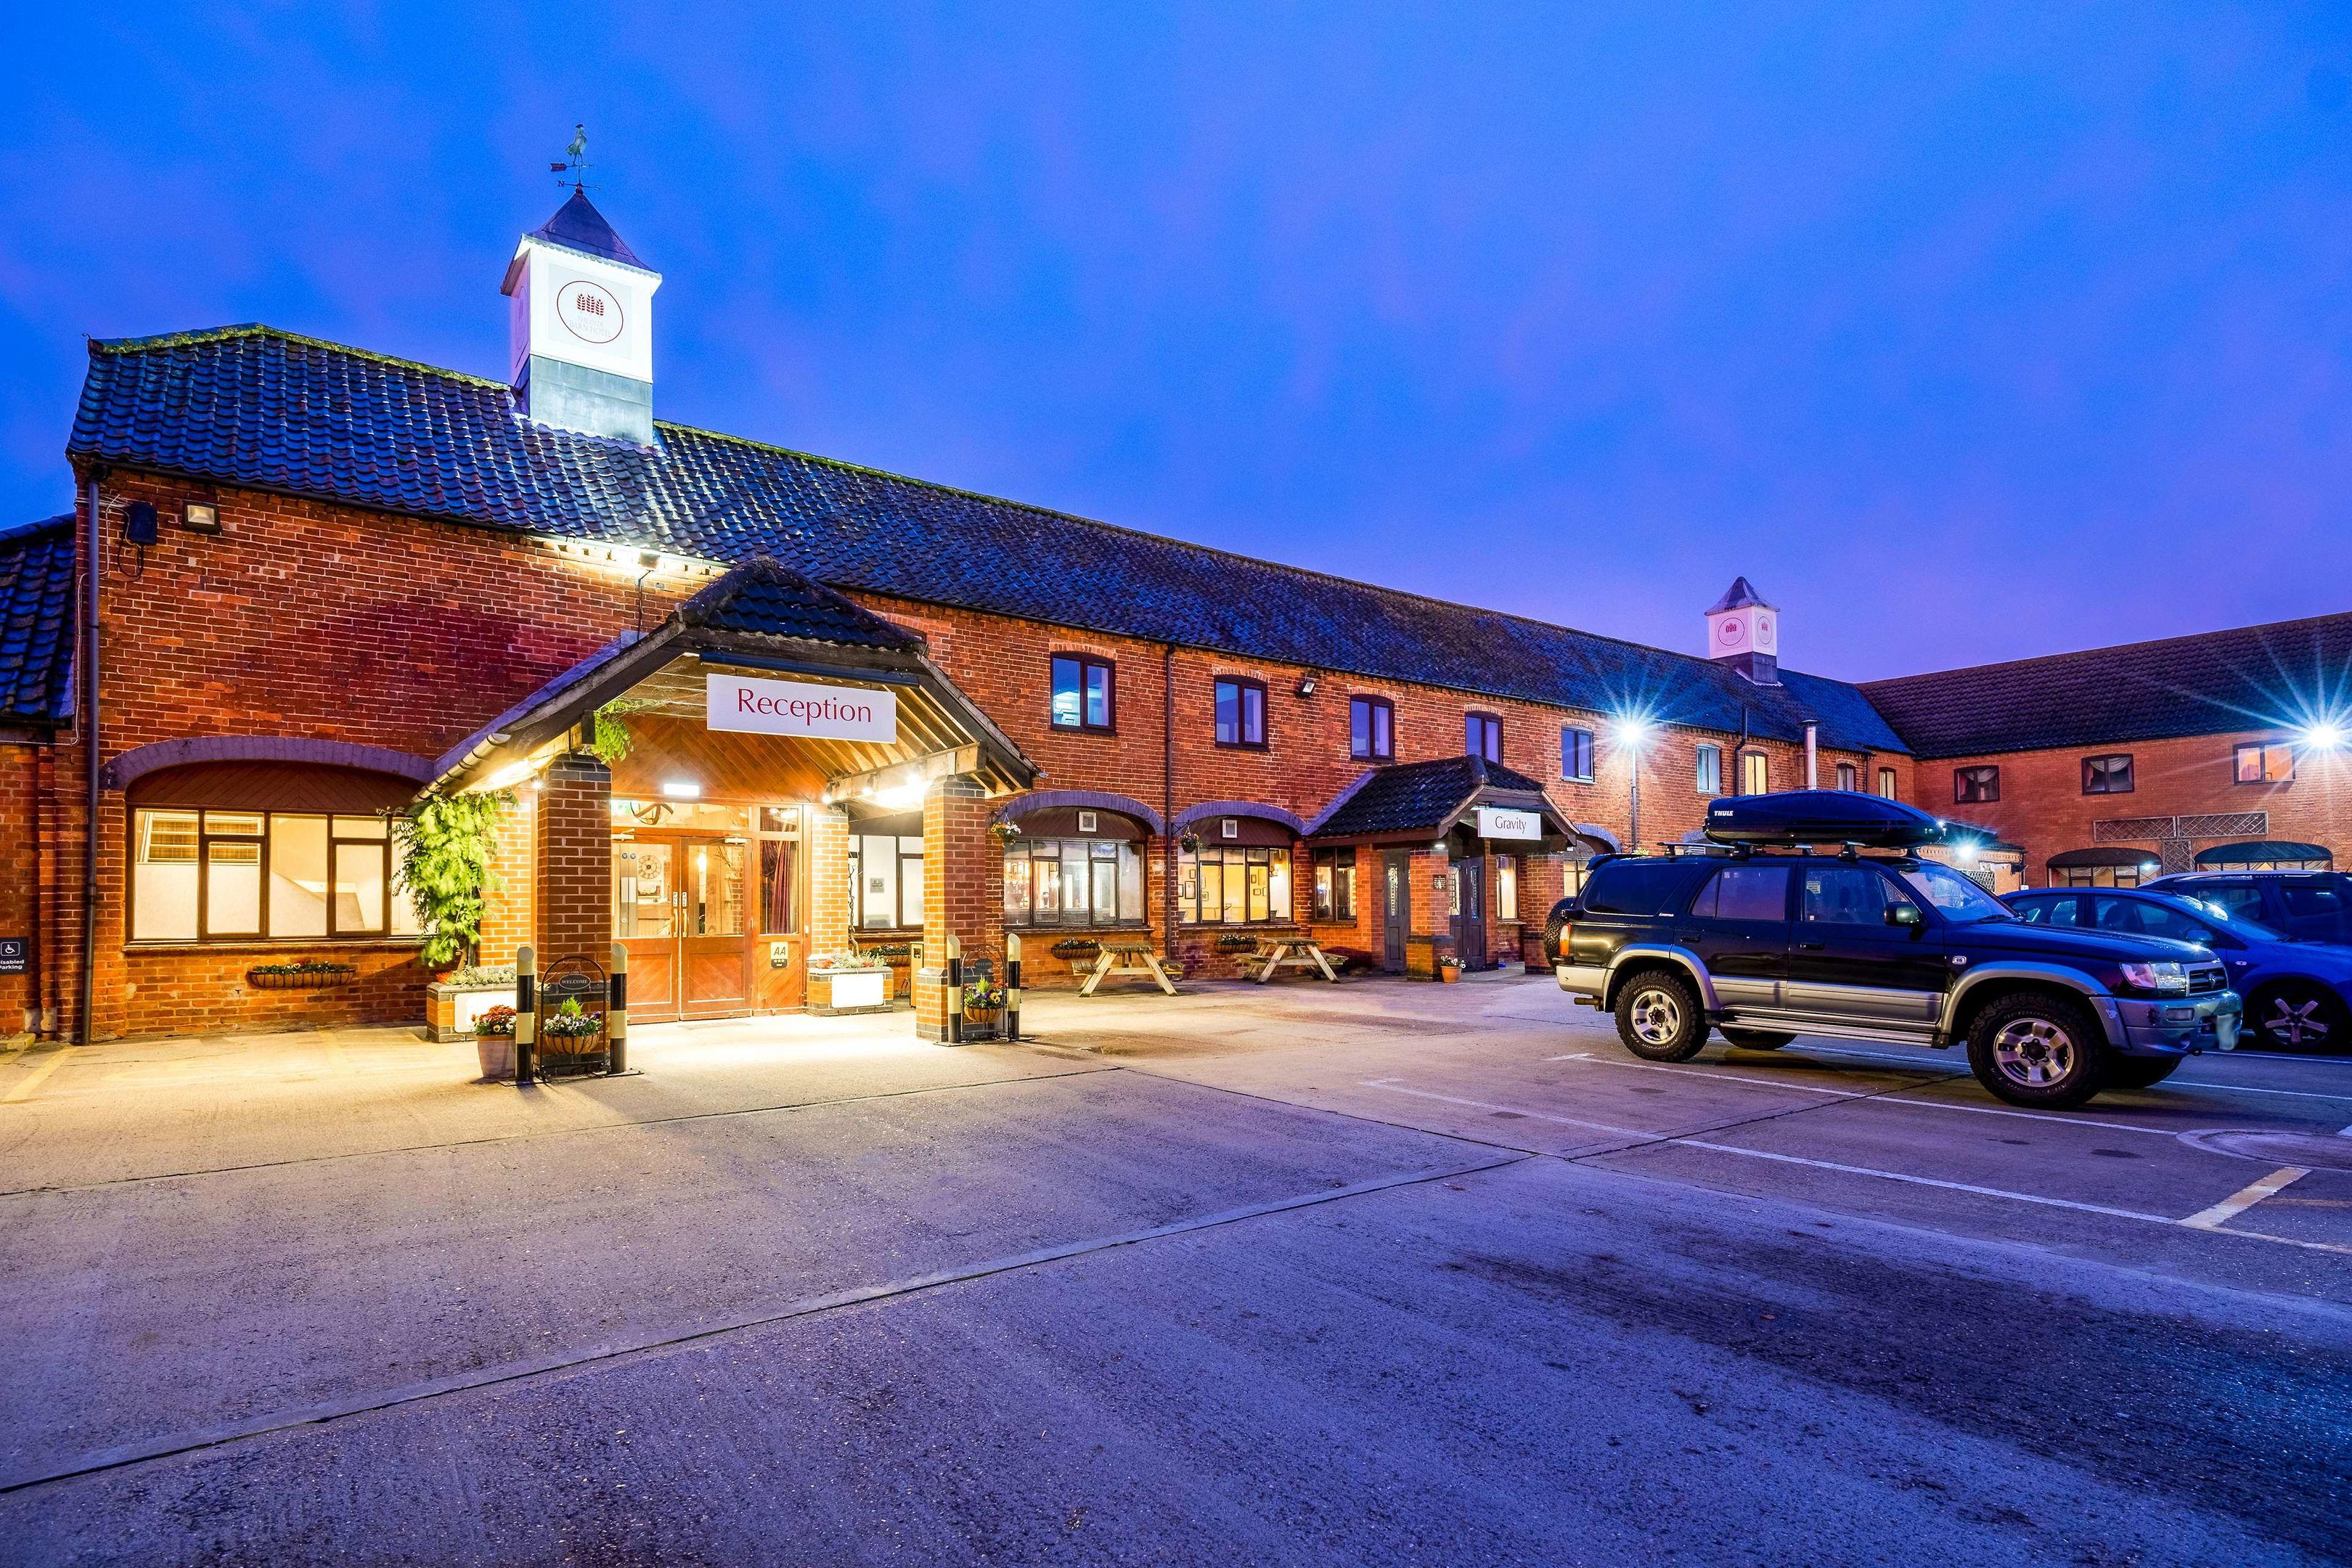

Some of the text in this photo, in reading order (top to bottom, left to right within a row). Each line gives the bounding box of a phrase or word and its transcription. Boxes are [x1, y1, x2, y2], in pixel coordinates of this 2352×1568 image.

[569, 319, 612, 338] BARN HOTEL
[738, 688, 871, 727] Reception
[1495, 815, 1527, 834] Gravity
[773, 947, 786, 956] AA
